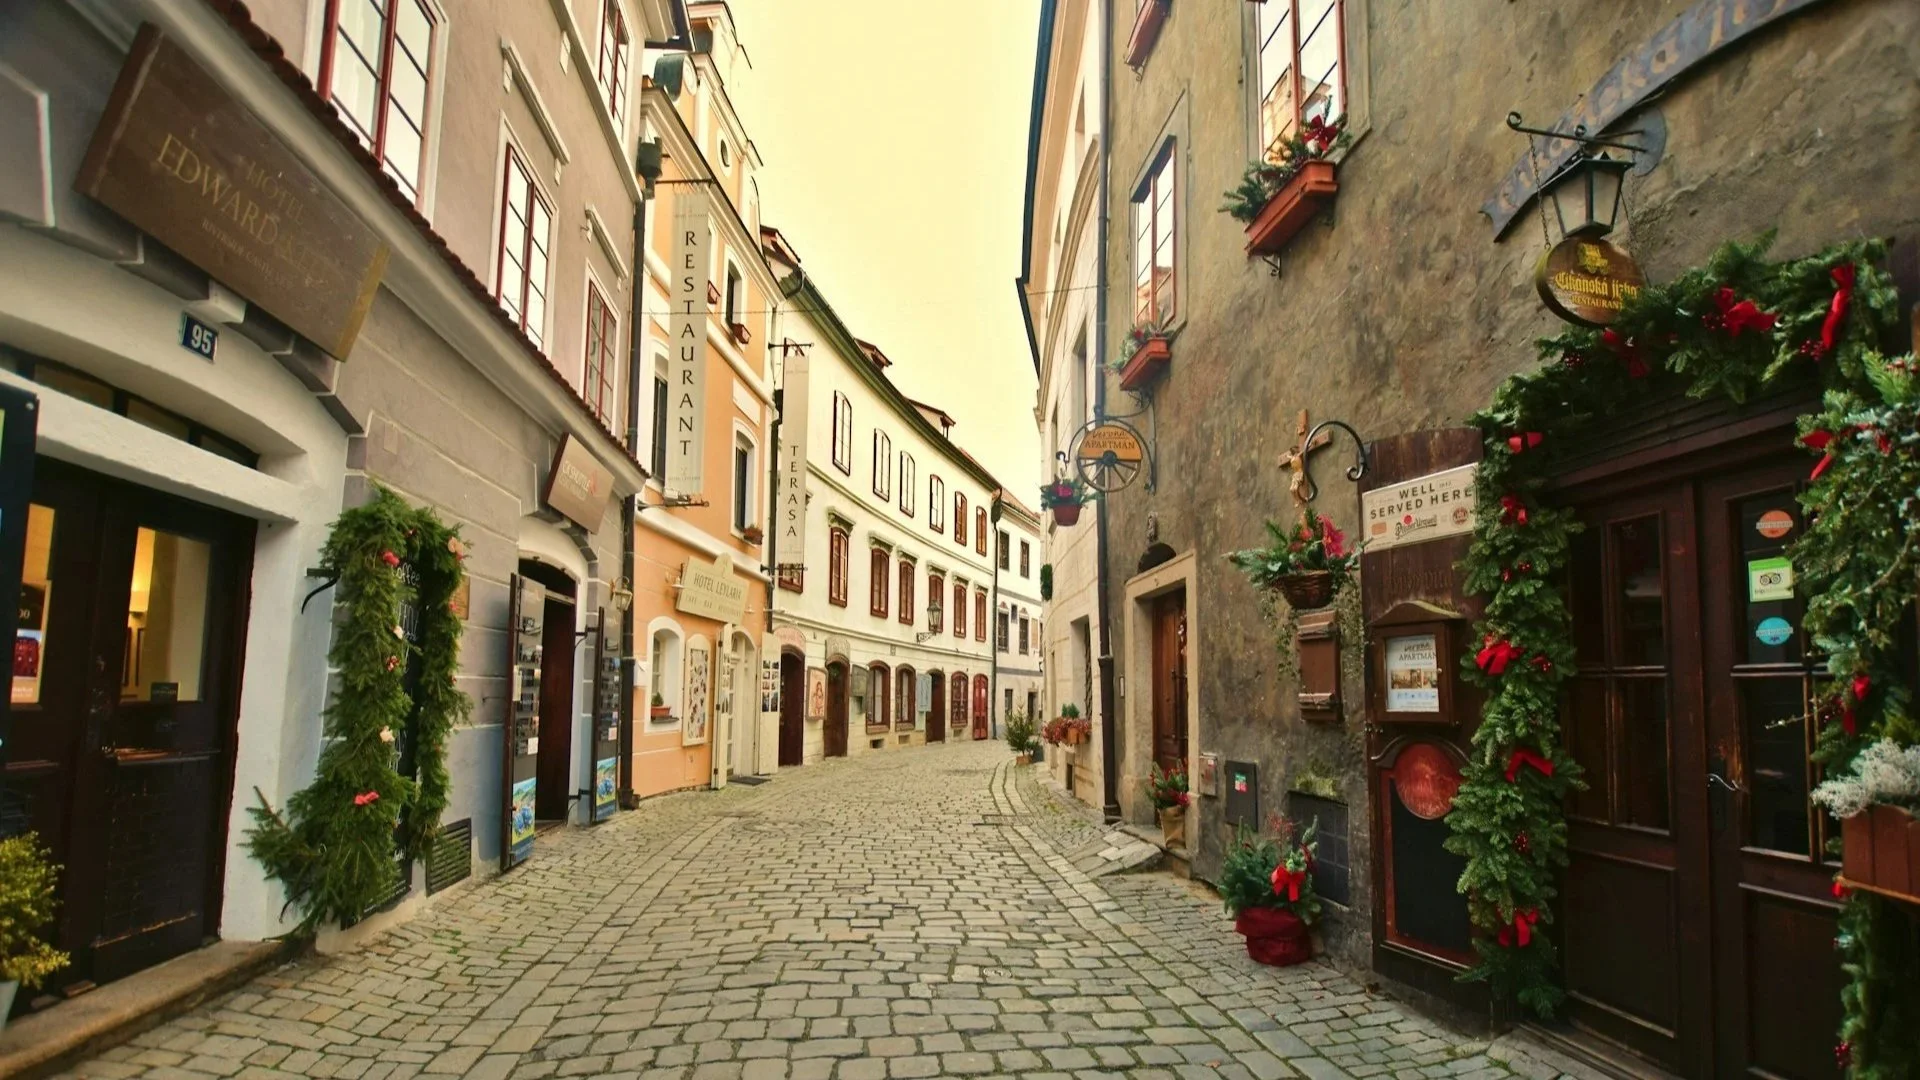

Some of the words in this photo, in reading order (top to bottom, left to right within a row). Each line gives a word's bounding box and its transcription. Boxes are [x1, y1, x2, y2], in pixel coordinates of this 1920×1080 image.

[158, 133, 279, 245] EDWARD
[246, 160, 305, 226] HOTEL
[191, 324, 213, 354] 95
[679, 230, 698, 456] RESTAURANT
[1084, 440, 1136, 449] APARTMAN
[786, 445, 800, 538] TERASA
[1370, 498, 1424, 519] SERVED
[1430, 488, 1473, 505] HERE
[1399, 482, 1436, 500] WELL
[693, 572, 715, 593] HOTEL
